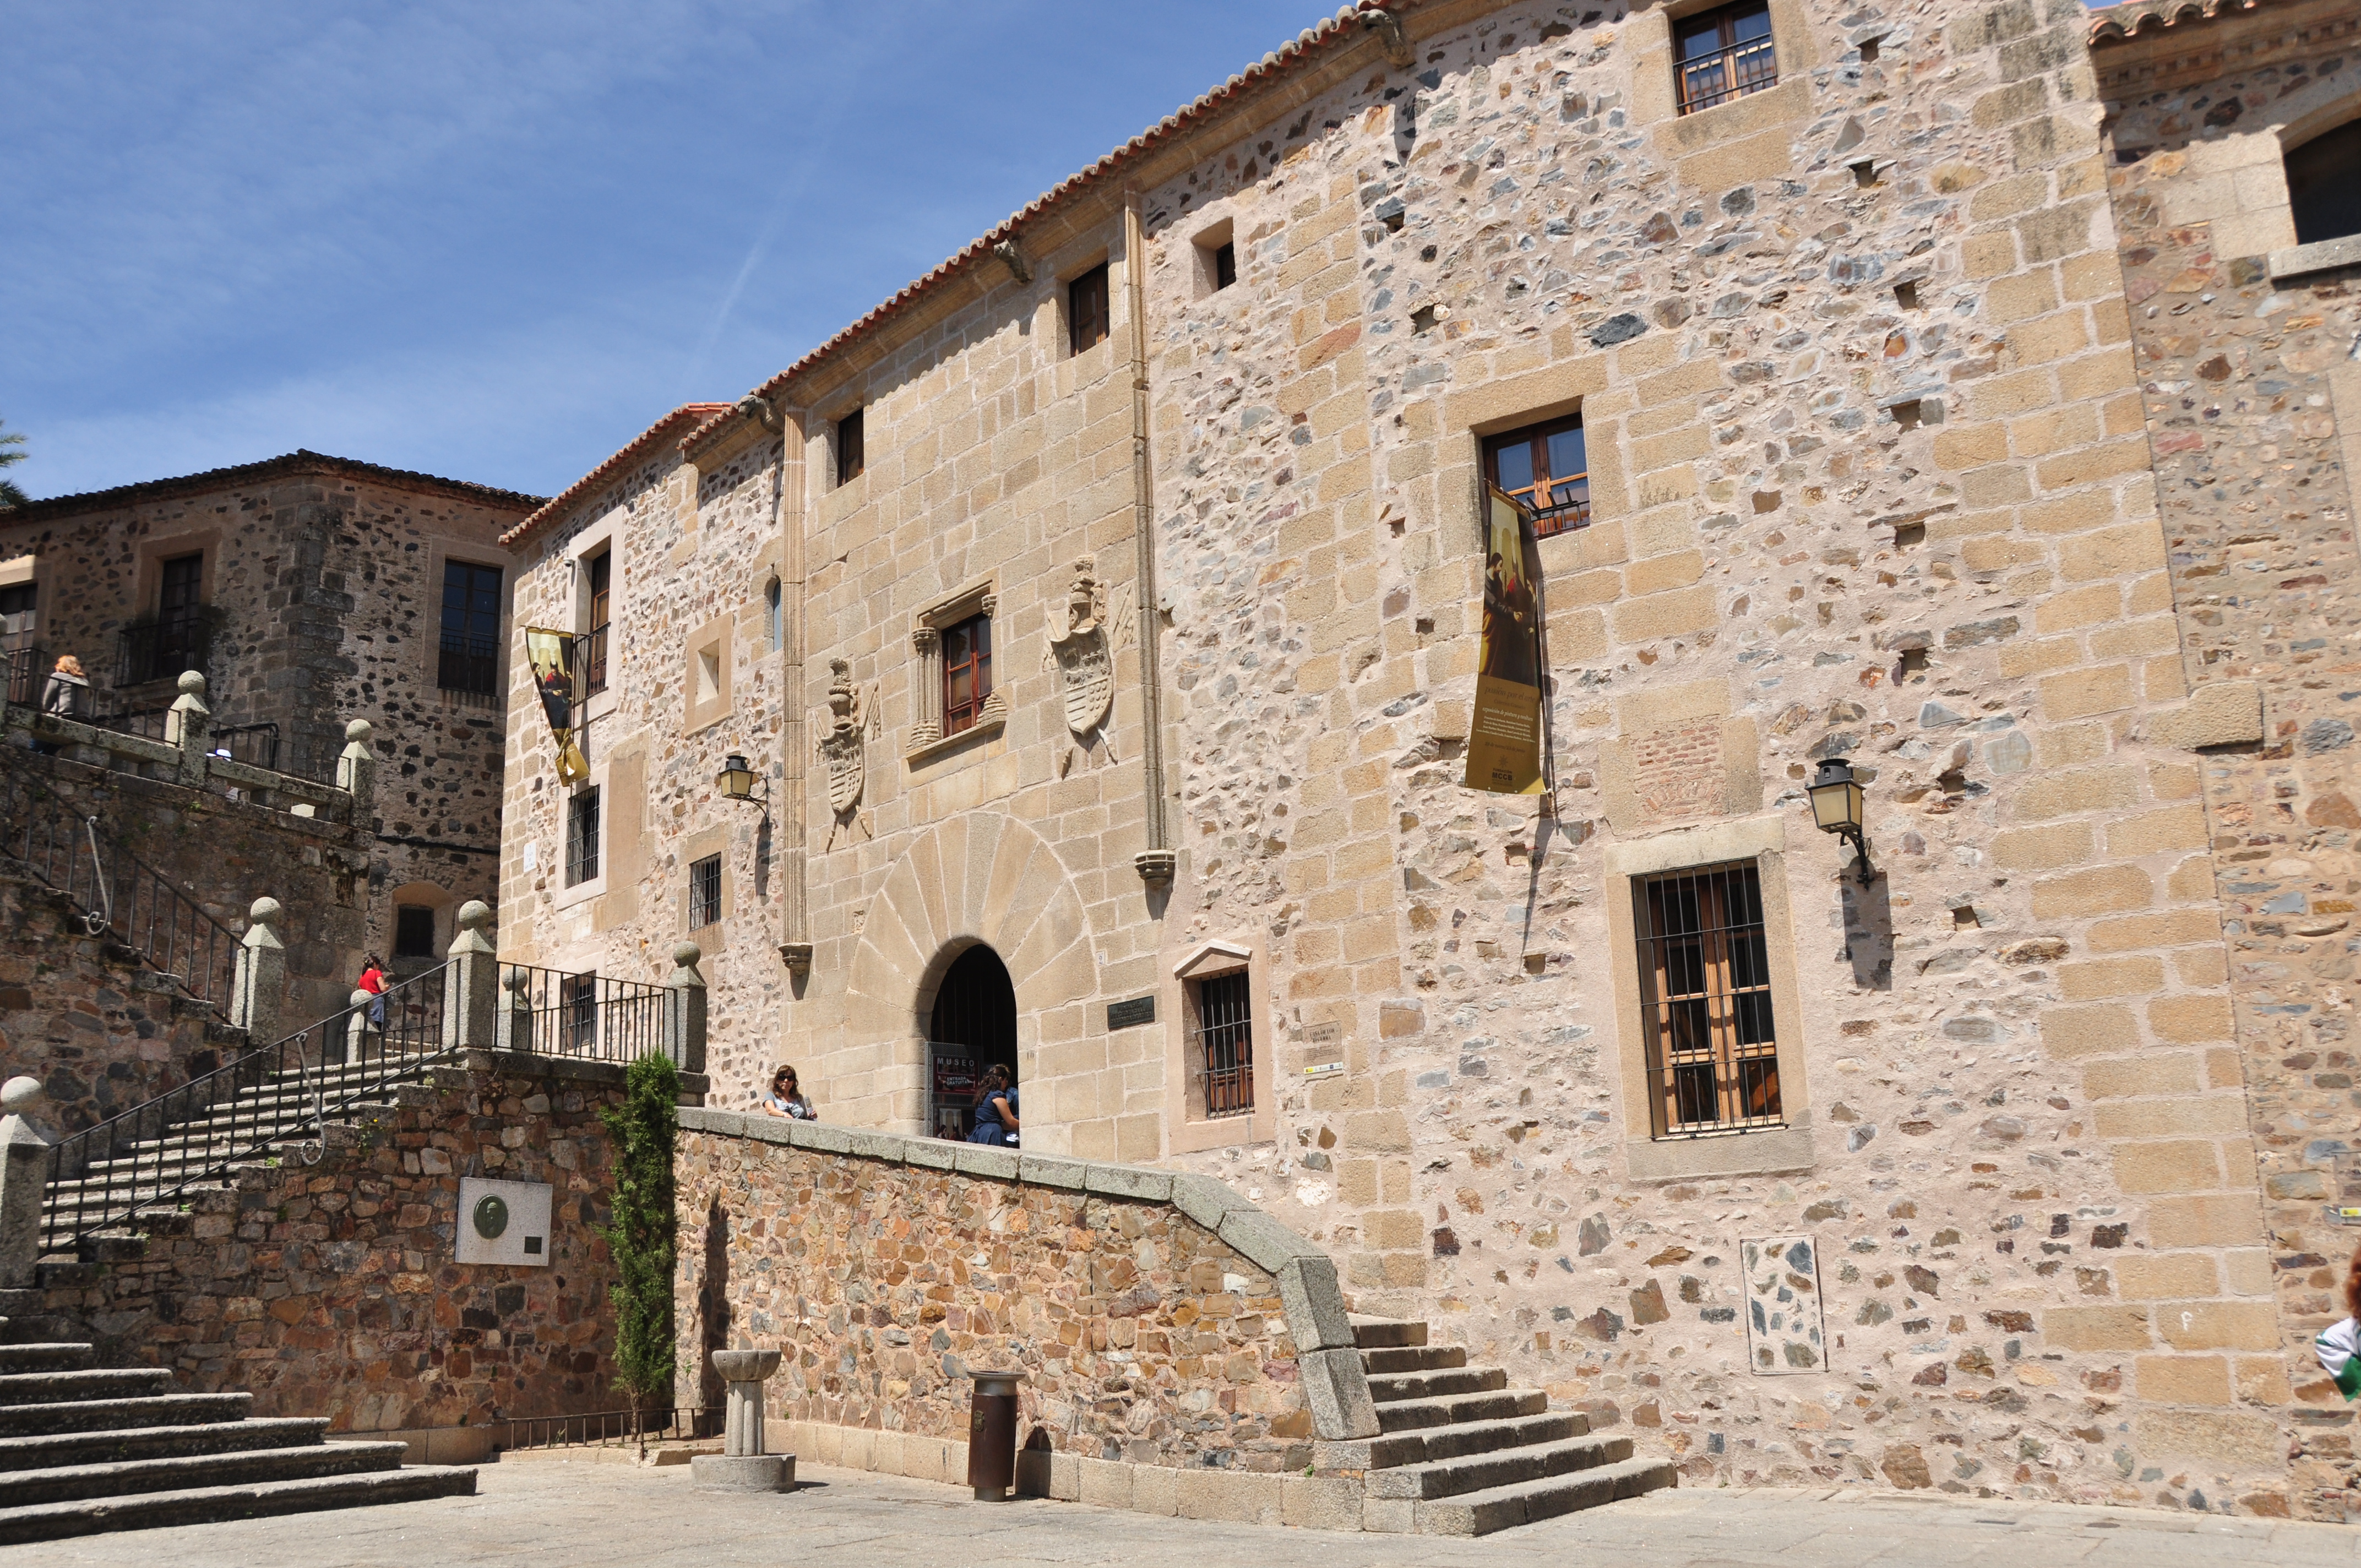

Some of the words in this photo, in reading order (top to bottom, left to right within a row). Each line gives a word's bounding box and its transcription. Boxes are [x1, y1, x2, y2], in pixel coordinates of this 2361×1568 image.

[1484, 687, 1505, 695] pasión
[1492, 772, 1513, 781] MCCB
[1098, 955, 1103, 964] 2
[937, 1058, 974, 1066] MUSEO
